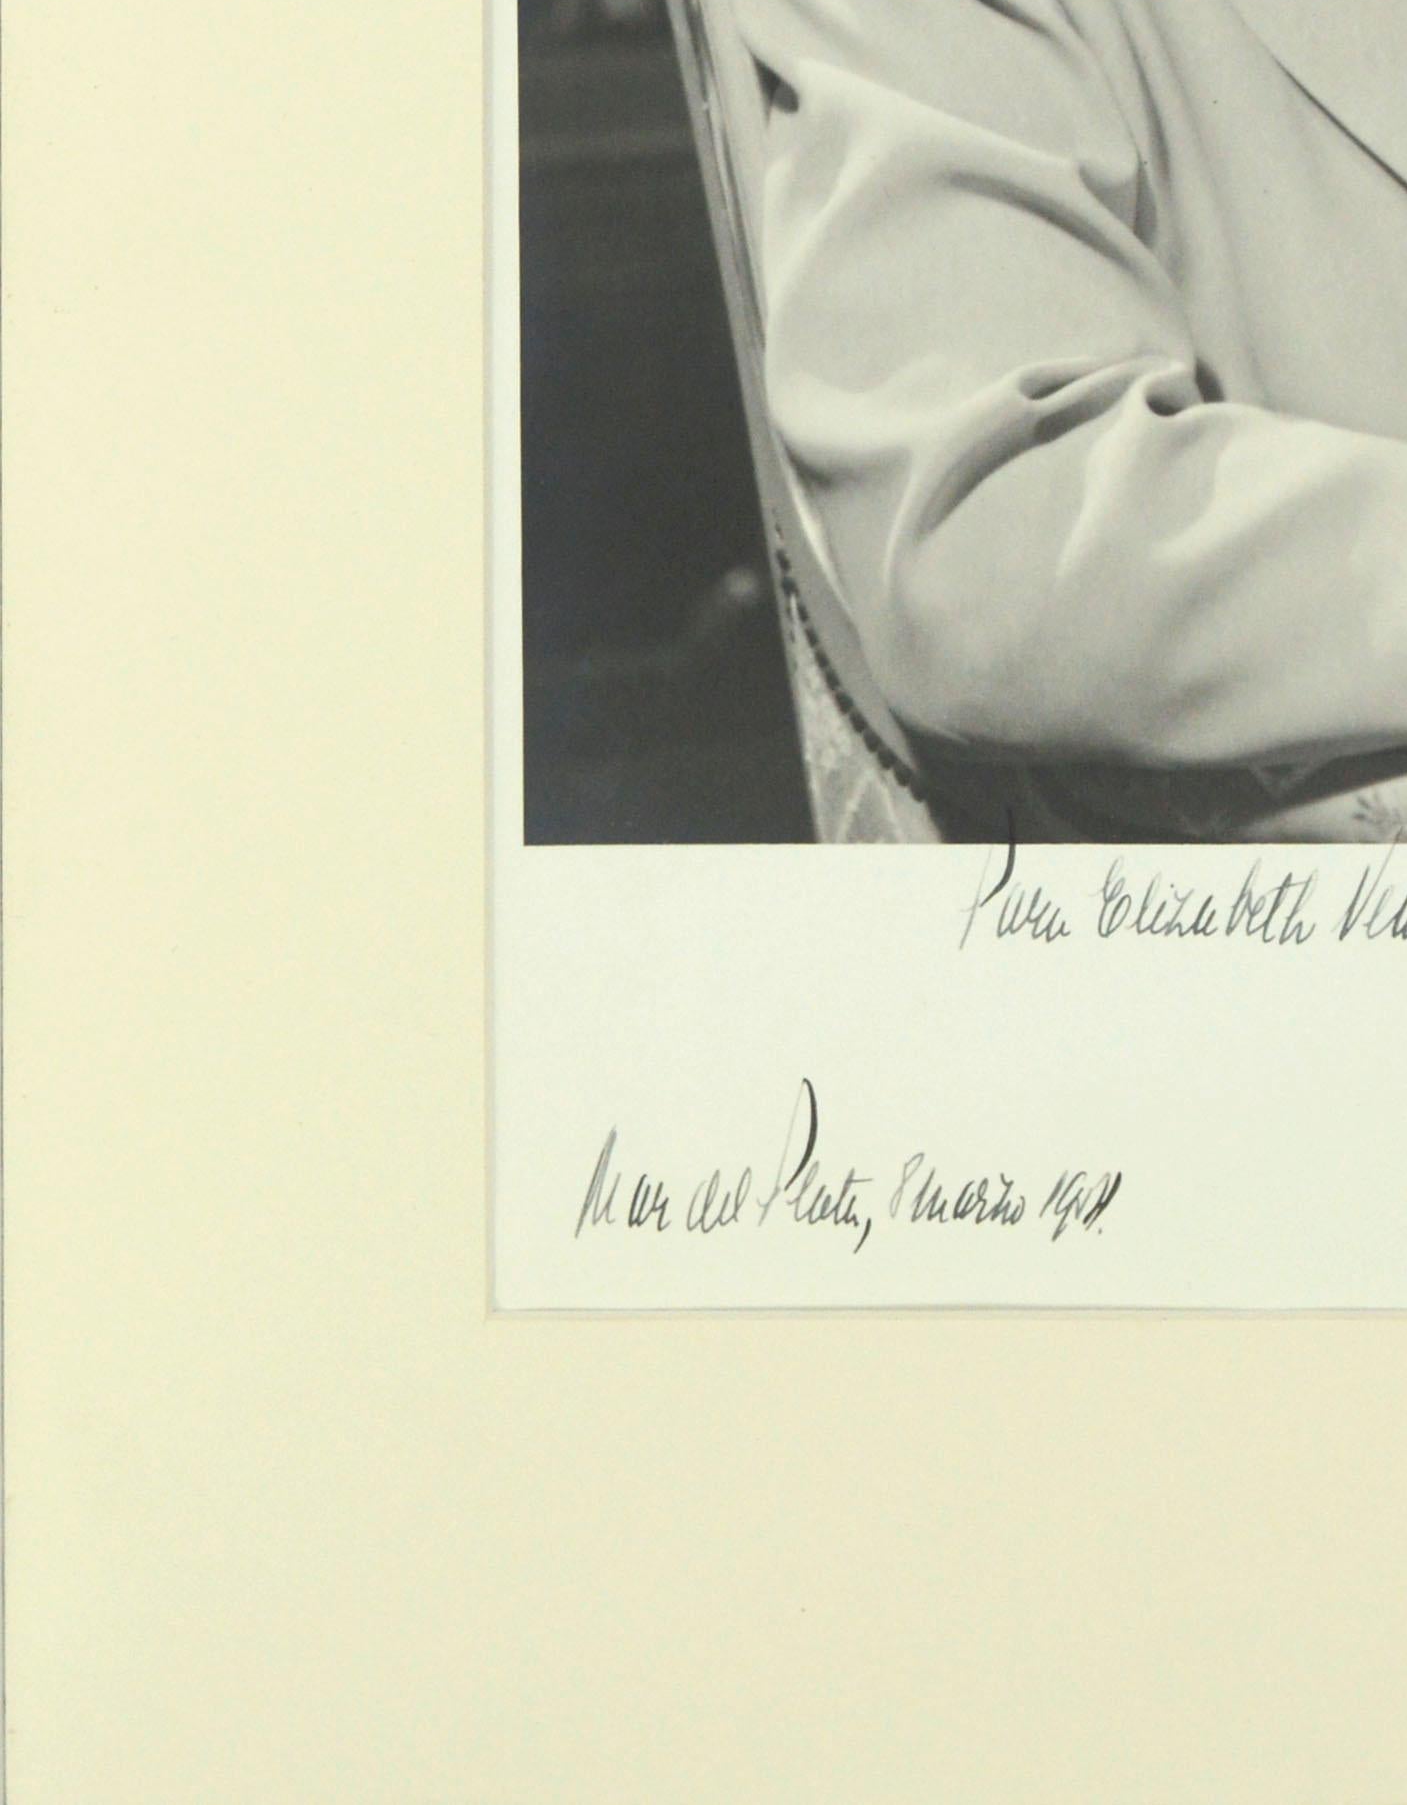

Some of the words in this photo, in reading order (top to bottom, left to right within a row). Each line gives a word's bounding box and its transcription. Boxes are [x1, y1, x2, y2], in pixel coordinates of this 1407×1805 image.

[957, 807, 1071, 951] Para
[1096, 855, 1319, 945] Elizabeth
[574, 1124, 671, 1239] Mar
[685, 1165, 753, 1235] del
